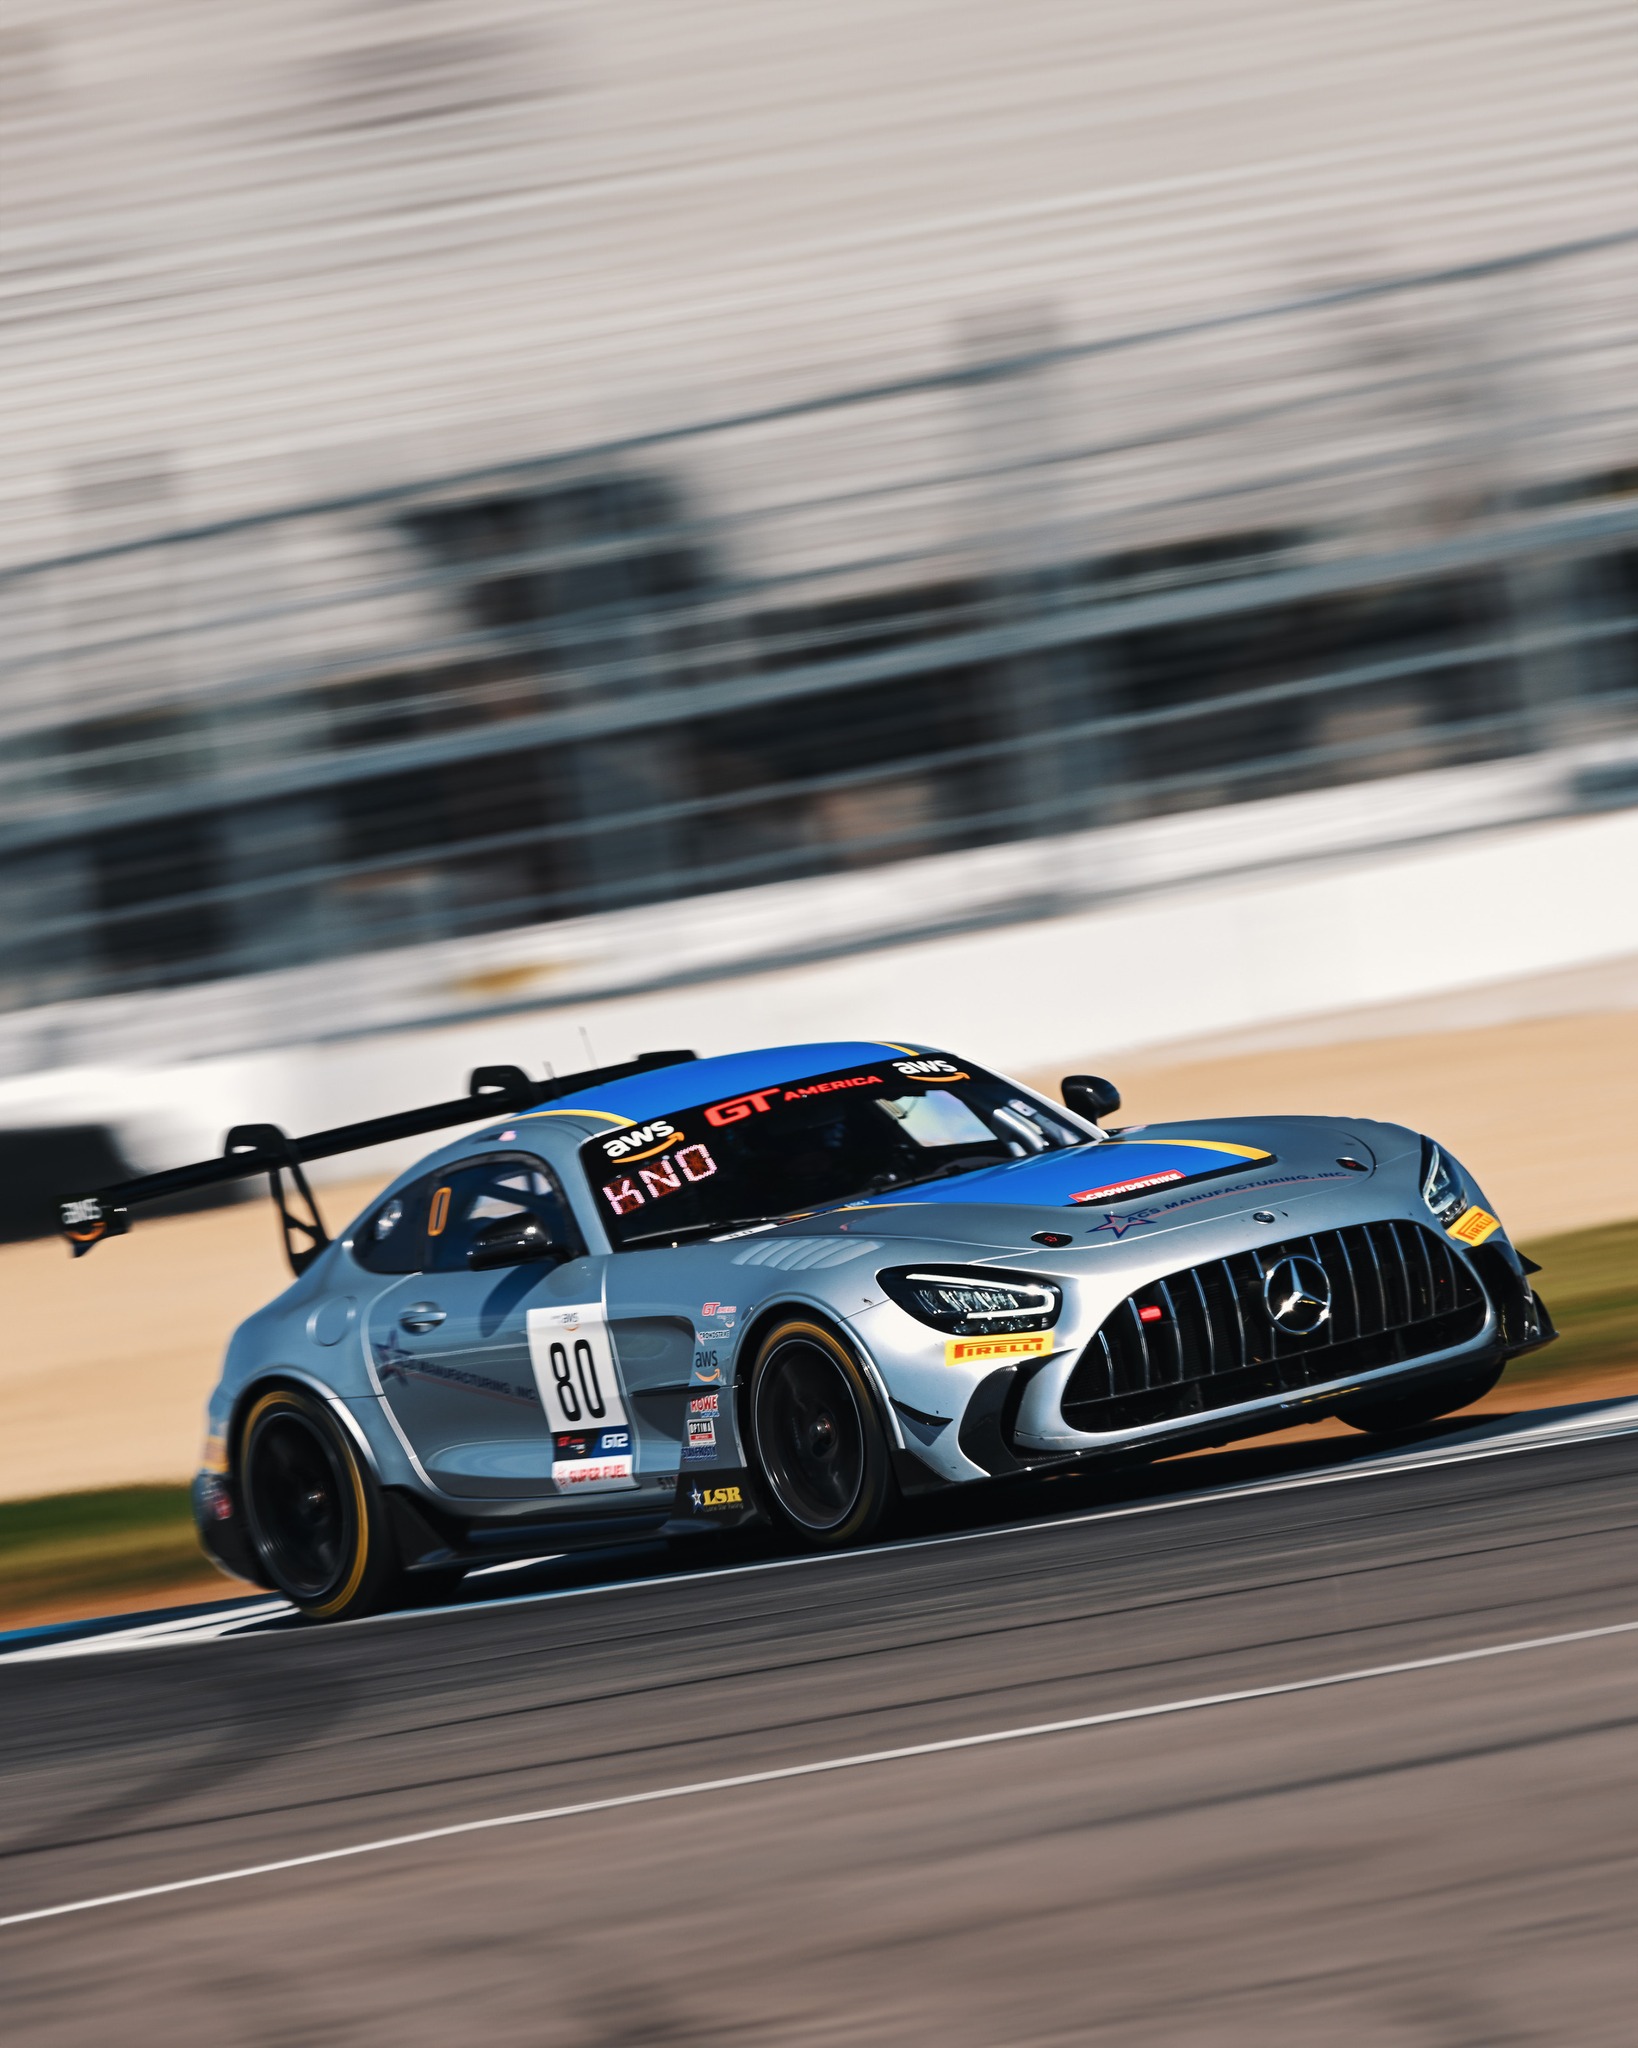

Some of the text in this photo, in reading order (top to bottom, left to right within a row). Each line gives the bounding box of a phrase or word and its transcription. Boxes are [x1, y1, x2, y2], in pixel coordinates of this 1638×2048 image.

[892, 1059, 958, 1074] aws
[704, 1075, 884, 1127] GT AMERICA
[603, 1120, 675, 1158] aws
[602, 1143, 717, 1215] KNO
[1083, 1172, 1182, 1201] CROWDSTRIKE
[1127, 1206, 1161, 1223] ACS
[1164, 1174, 1317, 1210] MANUFACTURING,
[1456, 1211, 1495, 1241] PIRELLI
[702, 1302, 720, 1316] GT
[954, 1337, 1044, 1359] PIRELLI
[695, 1350, 718, 1368] aws
[550, 1338, 606, 1421] 80
[690, 1394, 718, 1412] ROWE
[689, 1422, 712, 1434] OPTIMA
[601, 1433, 628, 1449] GT2
[569, 1464, 628, 1483] SUPER FUEL
[703, 1486, 742, 1506] LSR
